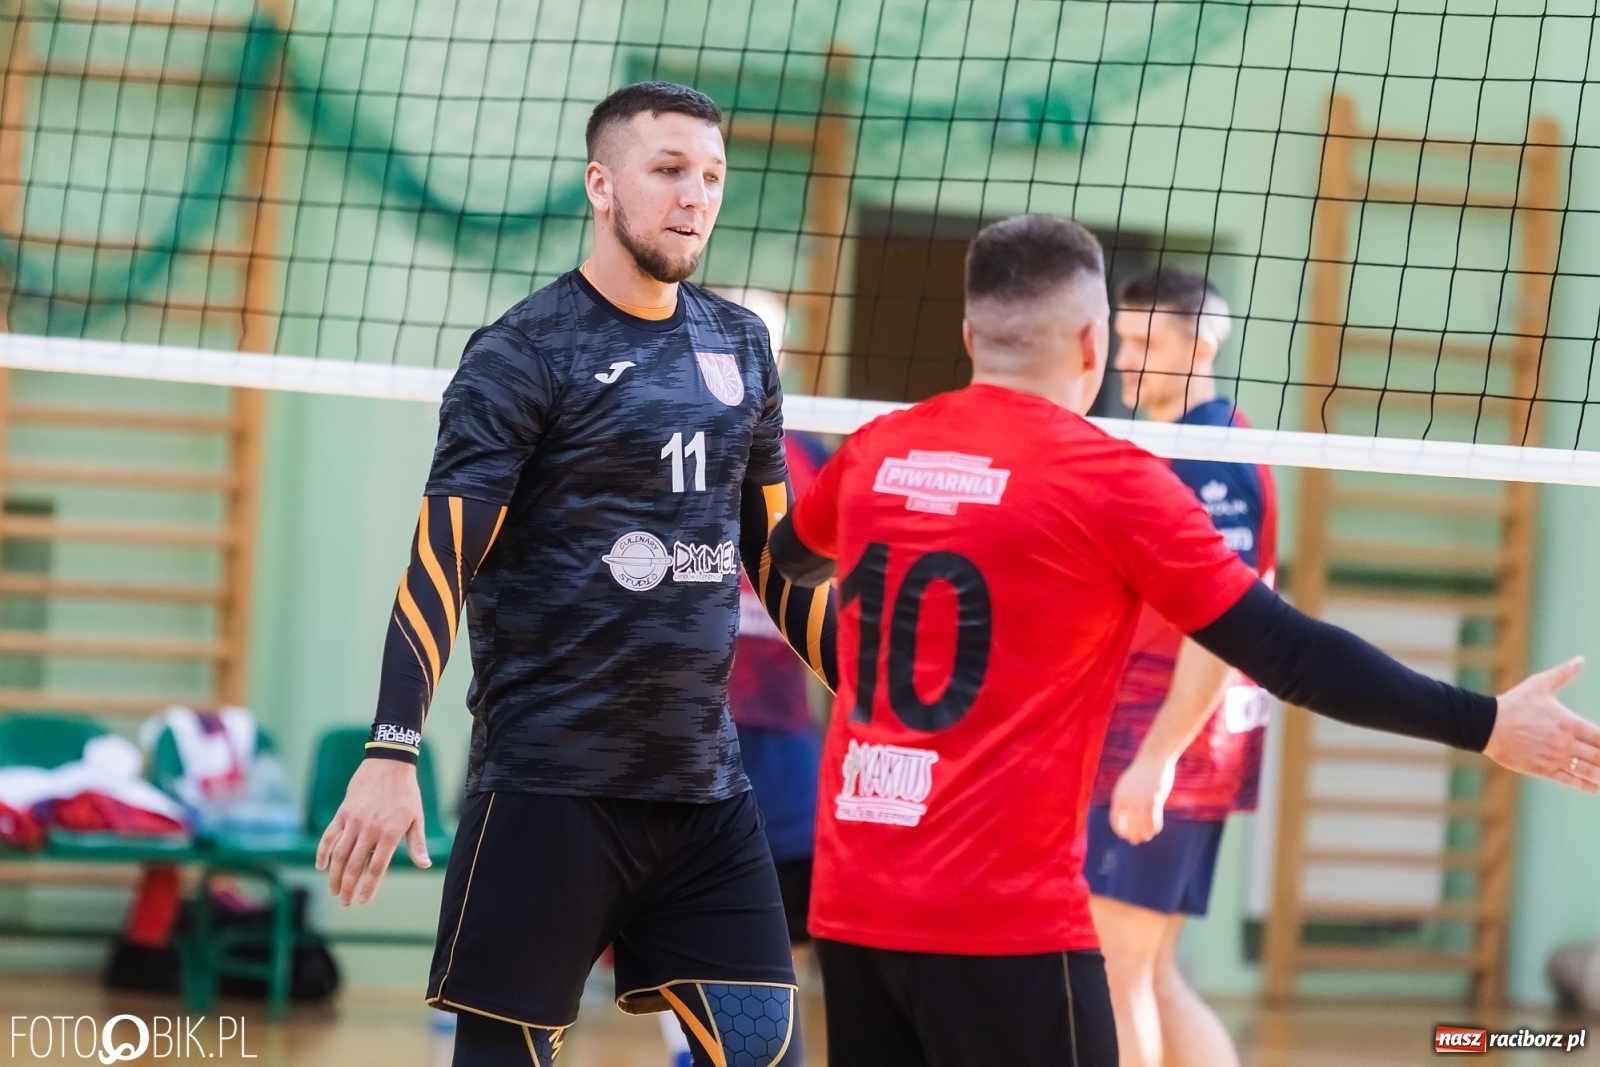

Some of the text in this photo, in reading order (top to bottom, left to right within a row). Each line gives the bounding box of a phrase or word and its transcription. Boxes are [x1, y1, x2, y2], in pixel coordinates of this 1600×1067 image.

[661, 431, 706, 493] 11
[887, 466, 994, 496] PIWIARNIA
[619, 535, 659, 550] CULINARY
[619, 573, 658, 587] STUDIO
[839, 542, 993, 733] 10
[375, 731, 422, 747] HOBBY
